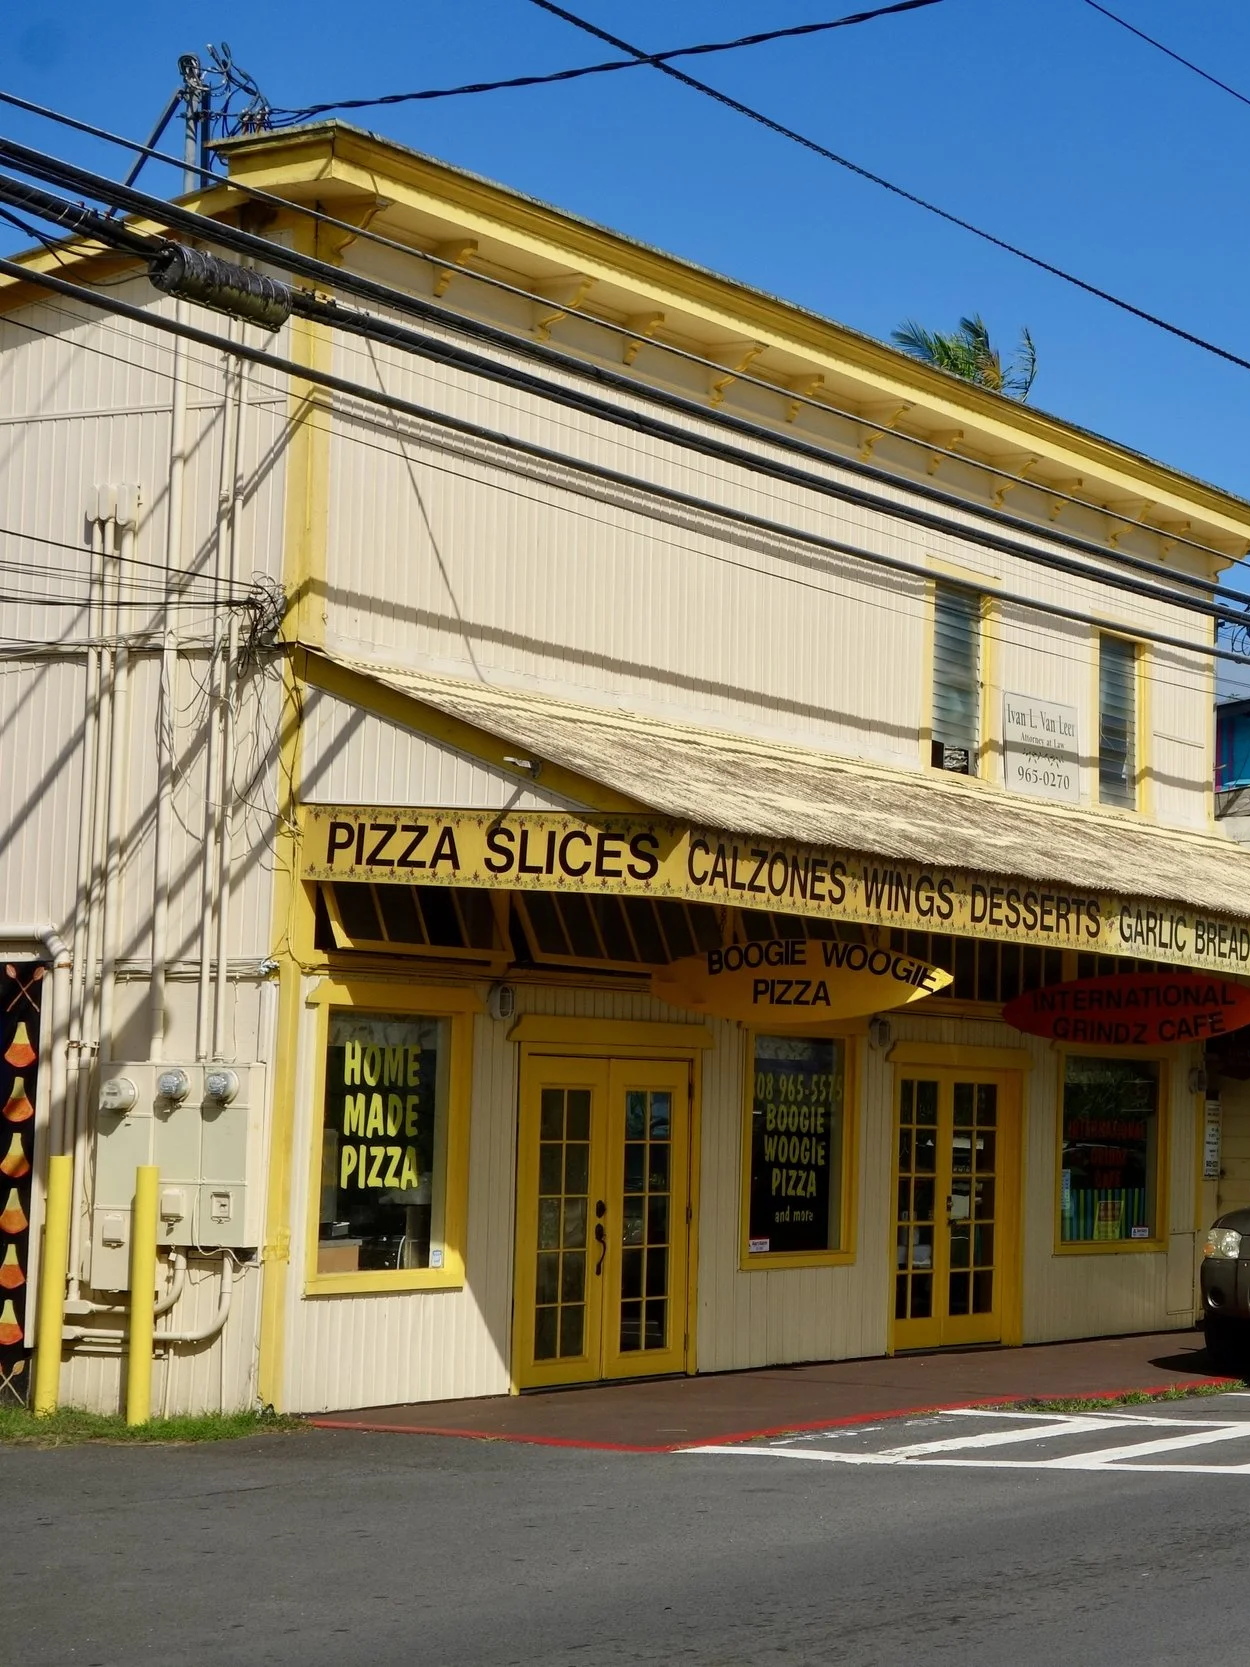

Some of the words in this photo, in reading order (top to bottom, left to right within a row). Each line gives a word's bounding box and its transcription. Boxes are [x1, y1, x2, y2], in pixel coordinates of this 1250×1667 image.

[1007, 704, 1026, 726] Ivan
[1029, 708, 1038, 729] L.
[1040, 711, 1056, 733] Van
[1059, 715, 1075, 737] Leer
[1021, 732, 1044, 748] Attorney
[1054, 739, 1065, 749] Law
[1018, 766, 1070, 790] 965-0270
[327, 821, 460, 871] PIZZA
[484, 828, 660, 881] SLICES
[688, 839, 846, 905] CALZONES
[863, 867, 954, 920] WINGS
[970, 883, 1101, 939] DESSERTS
[1119, 905, 1187, 952] GARLIC
[1194, 919, 1250, 962] BREAD
[707, 939, 807, 975] BOOGIE
[821, 942, 938, 993] WOOGIE
[752, 978, 832, 1007] PIZZA
[1032, 983, 1236, 1014] INTERNATIONAL
[1052, 1016, 1149, 1045] GRINDZ
[1158, 1010, 1227, 1042] CAFE
[344, 1040, 422, 1087] HOME
[754, 1072, 774, 1100] 08
[343, 1092, 420, 1139] MADE
[766, 1103, 825, 1134] BOOGIE
[764, 1134, 827, 1166] WOOGIE
[340, 1144, 419, 1191] PIZZA
[771, 1167, 817, 1199] PIZZA
[775, 1205, 790, 1223] and
[793, 1211, 814, 1223] more
